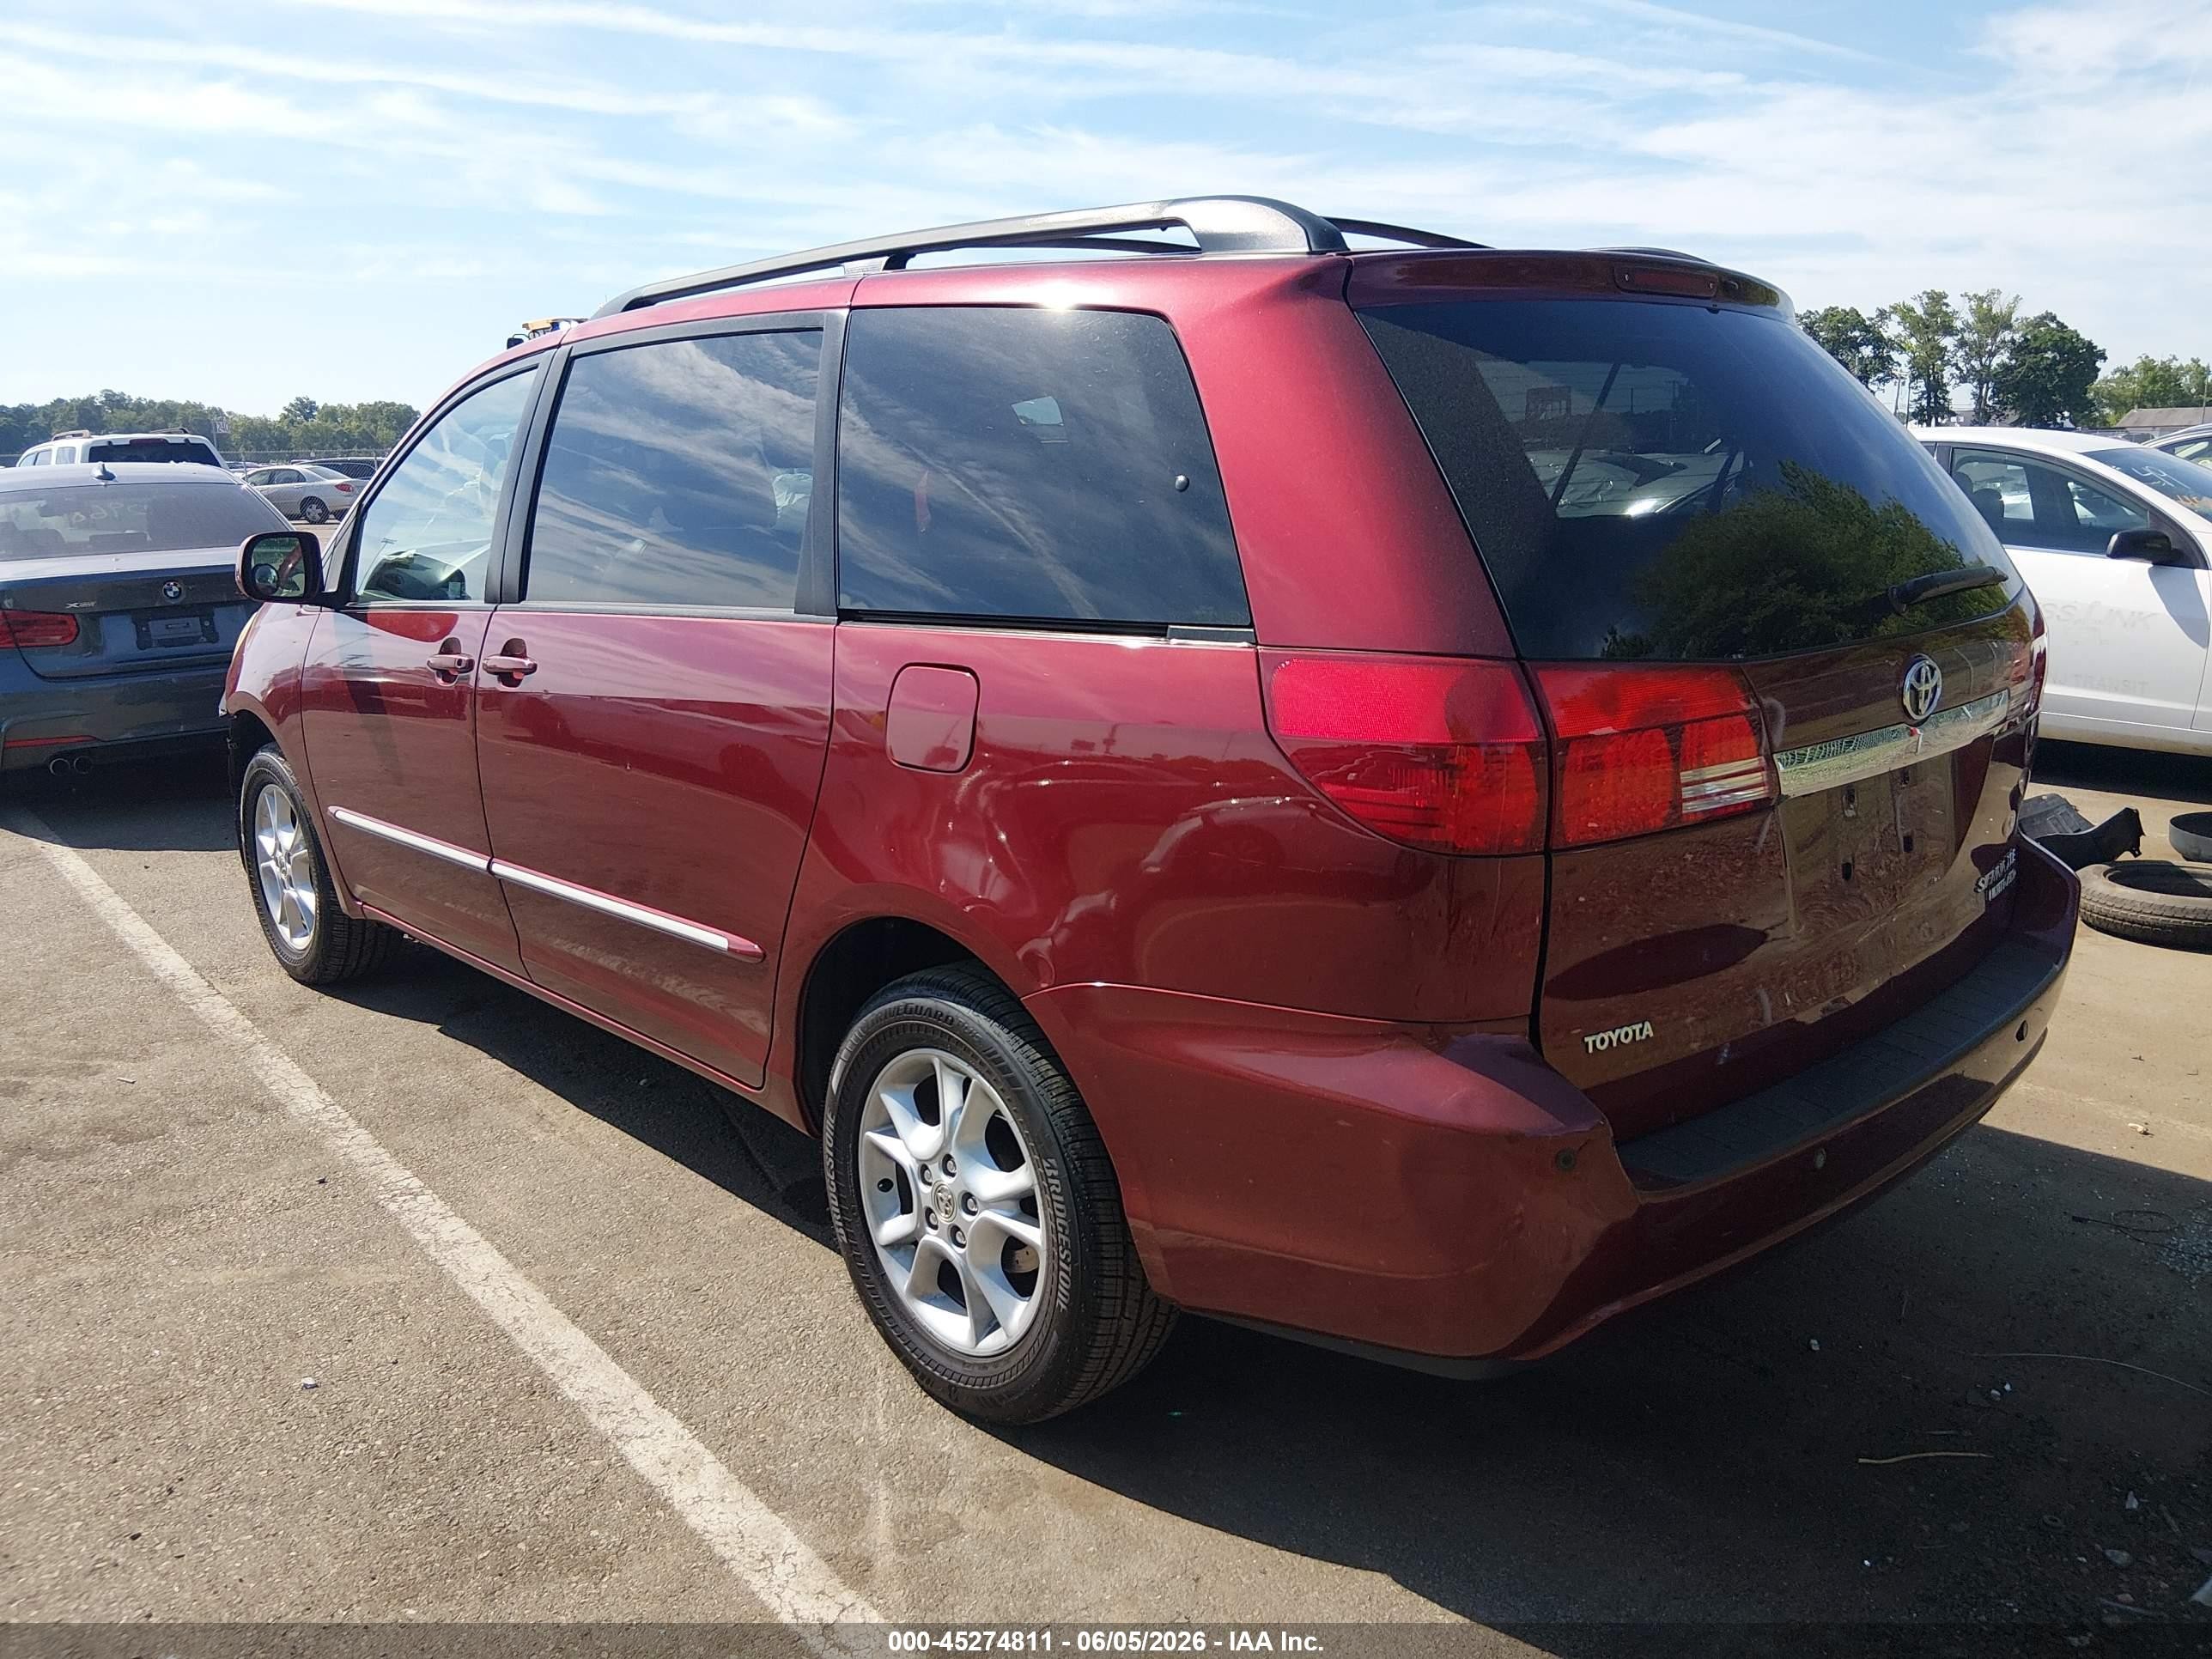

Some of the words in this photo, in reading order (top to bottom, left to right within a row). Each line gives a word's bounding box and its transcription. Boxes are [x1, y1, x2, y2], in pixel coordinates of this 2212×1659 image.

[1583, 1020, 1654, 1054] TOYOTA
[825, 1110, 848, 1244] BRIDGESTONE
[1042, 1158, 1073, 1313] BRIDGESTONE
